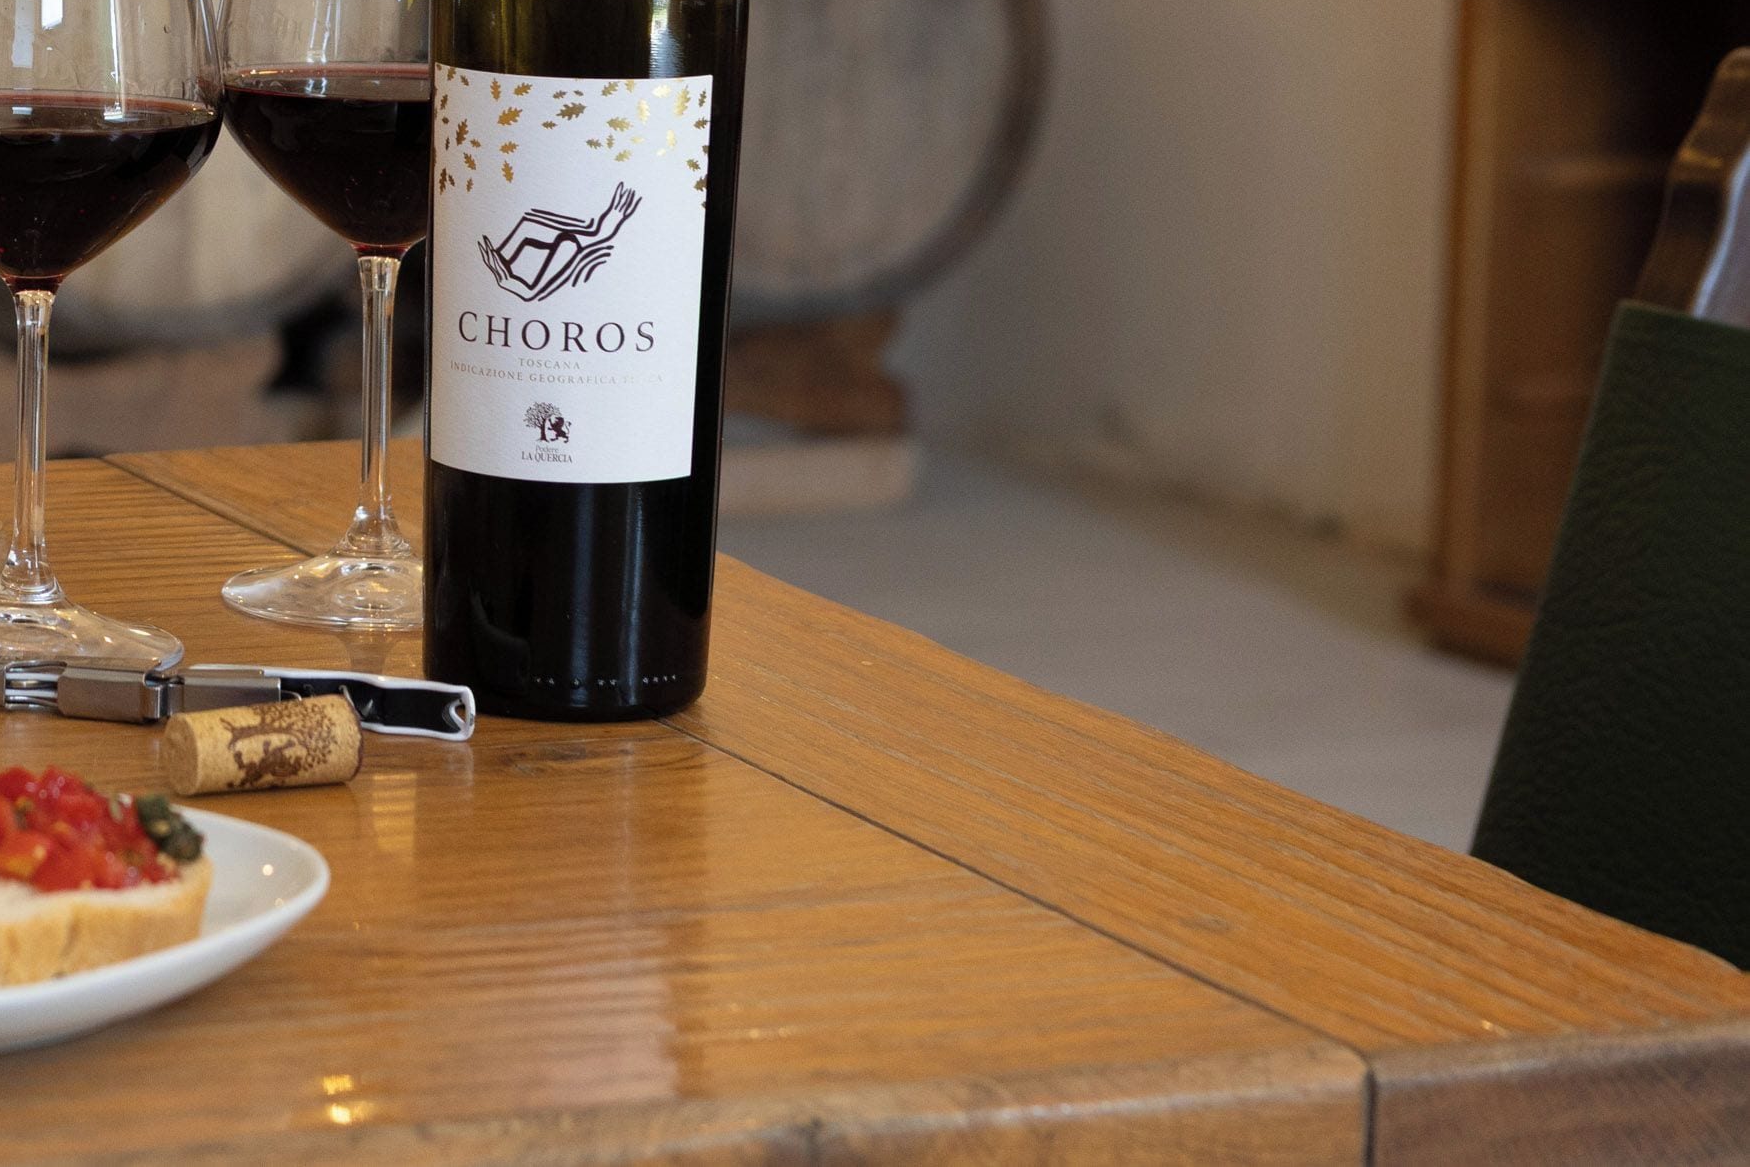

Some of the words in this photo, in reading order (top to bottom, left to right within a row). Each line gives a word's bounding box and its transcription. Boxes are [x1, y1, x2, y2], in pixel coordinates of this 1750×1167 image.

[458, 310, 655, 353] CHOROS
[518, 357, 581, 370] TOSCANA
[450, 359, 524, 381] INDICAZIONE
[529, 373, 616, 385] GEOGRAFICA
[535, 445, 560, 454] Podere
[521, 451, 533, 461] LA
[534, 452, 573, 464] QUERCIA
